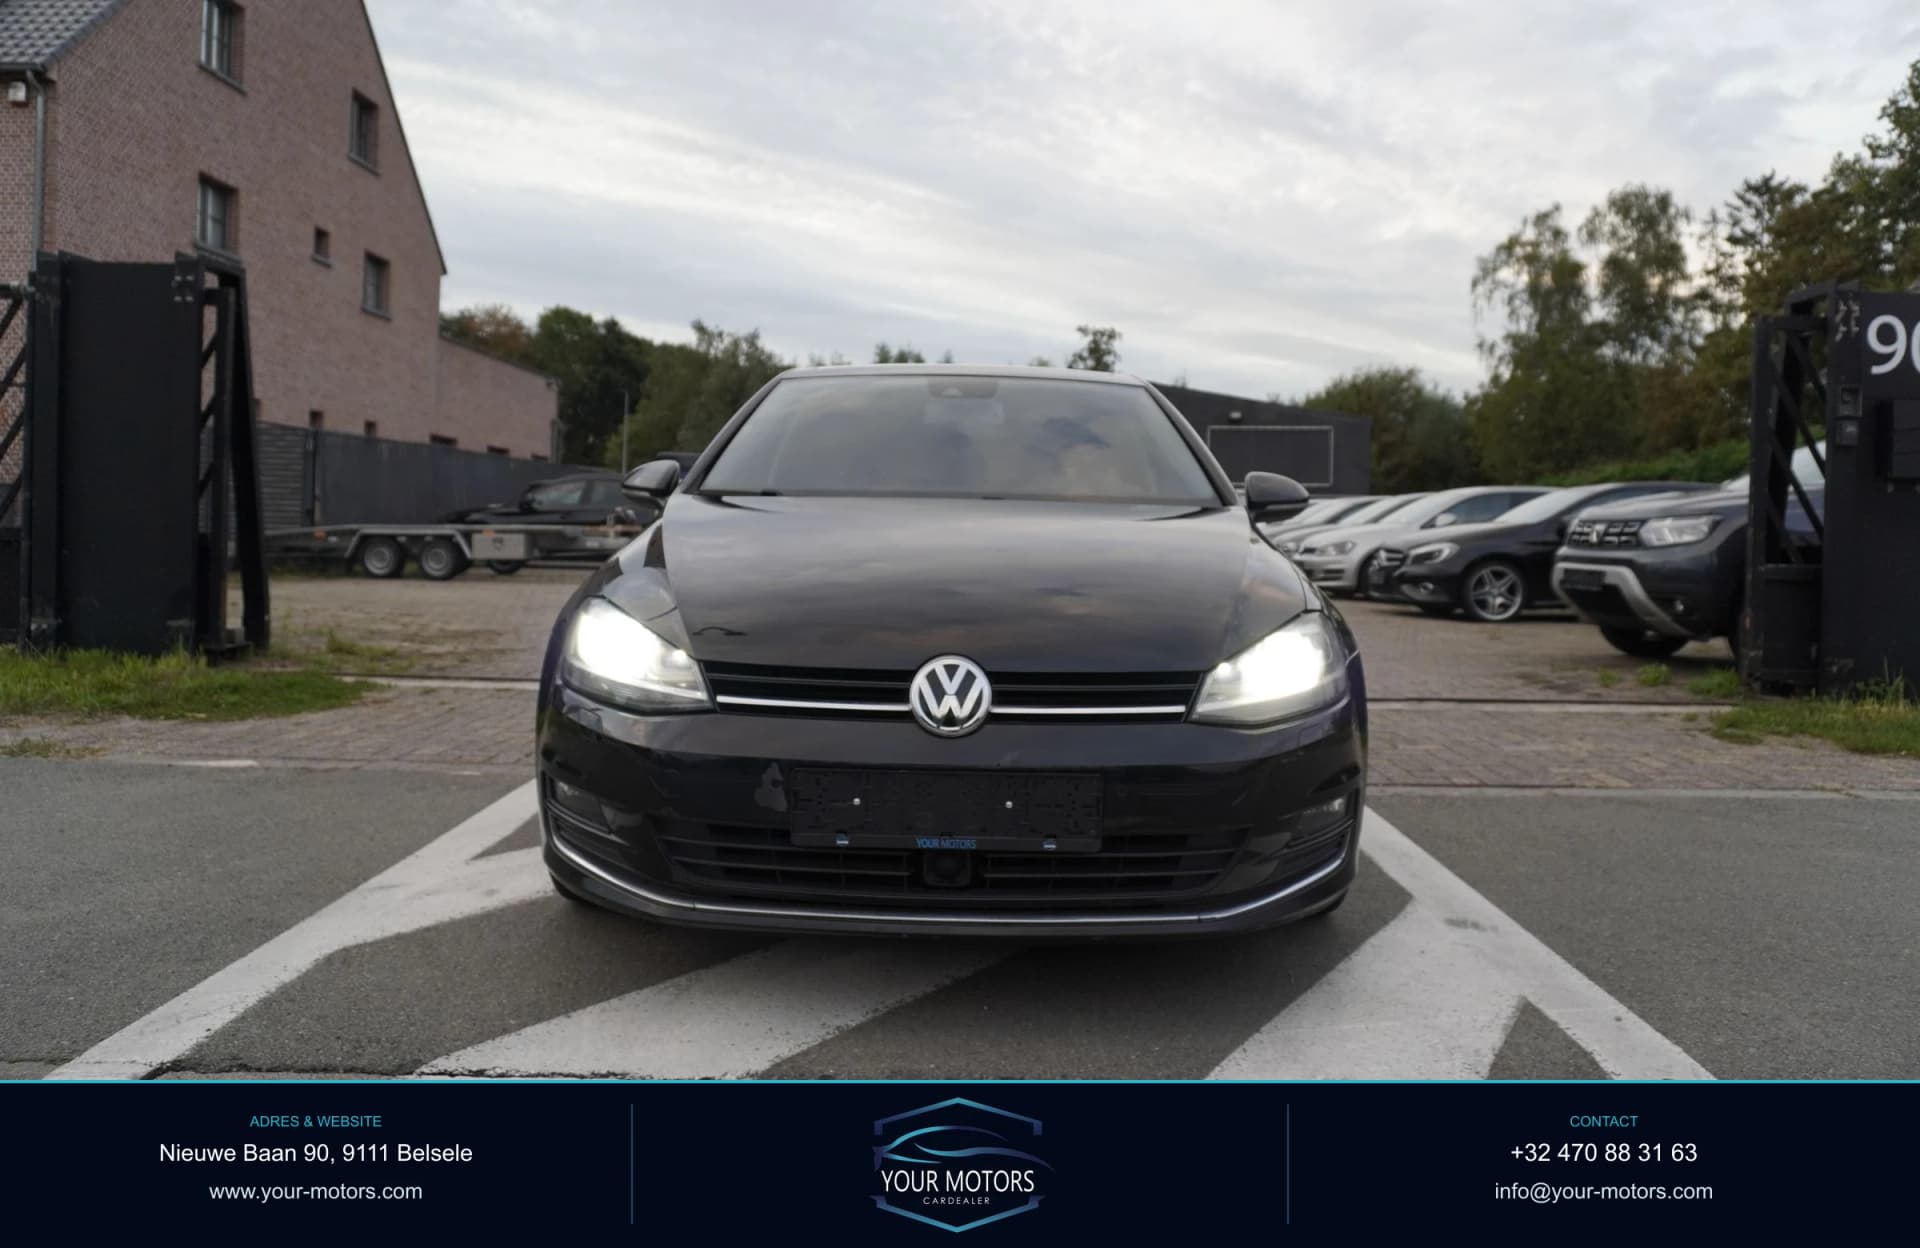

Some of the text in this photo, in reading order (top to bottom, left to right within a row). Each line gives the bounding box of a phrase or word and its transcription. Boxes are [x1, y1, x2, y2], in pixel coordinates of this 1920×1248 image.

[1867, 314, 1920, 375] 9
[914, 657, 988, 724] VW
[916, 838, 977, 849] YOUR MOTORS
